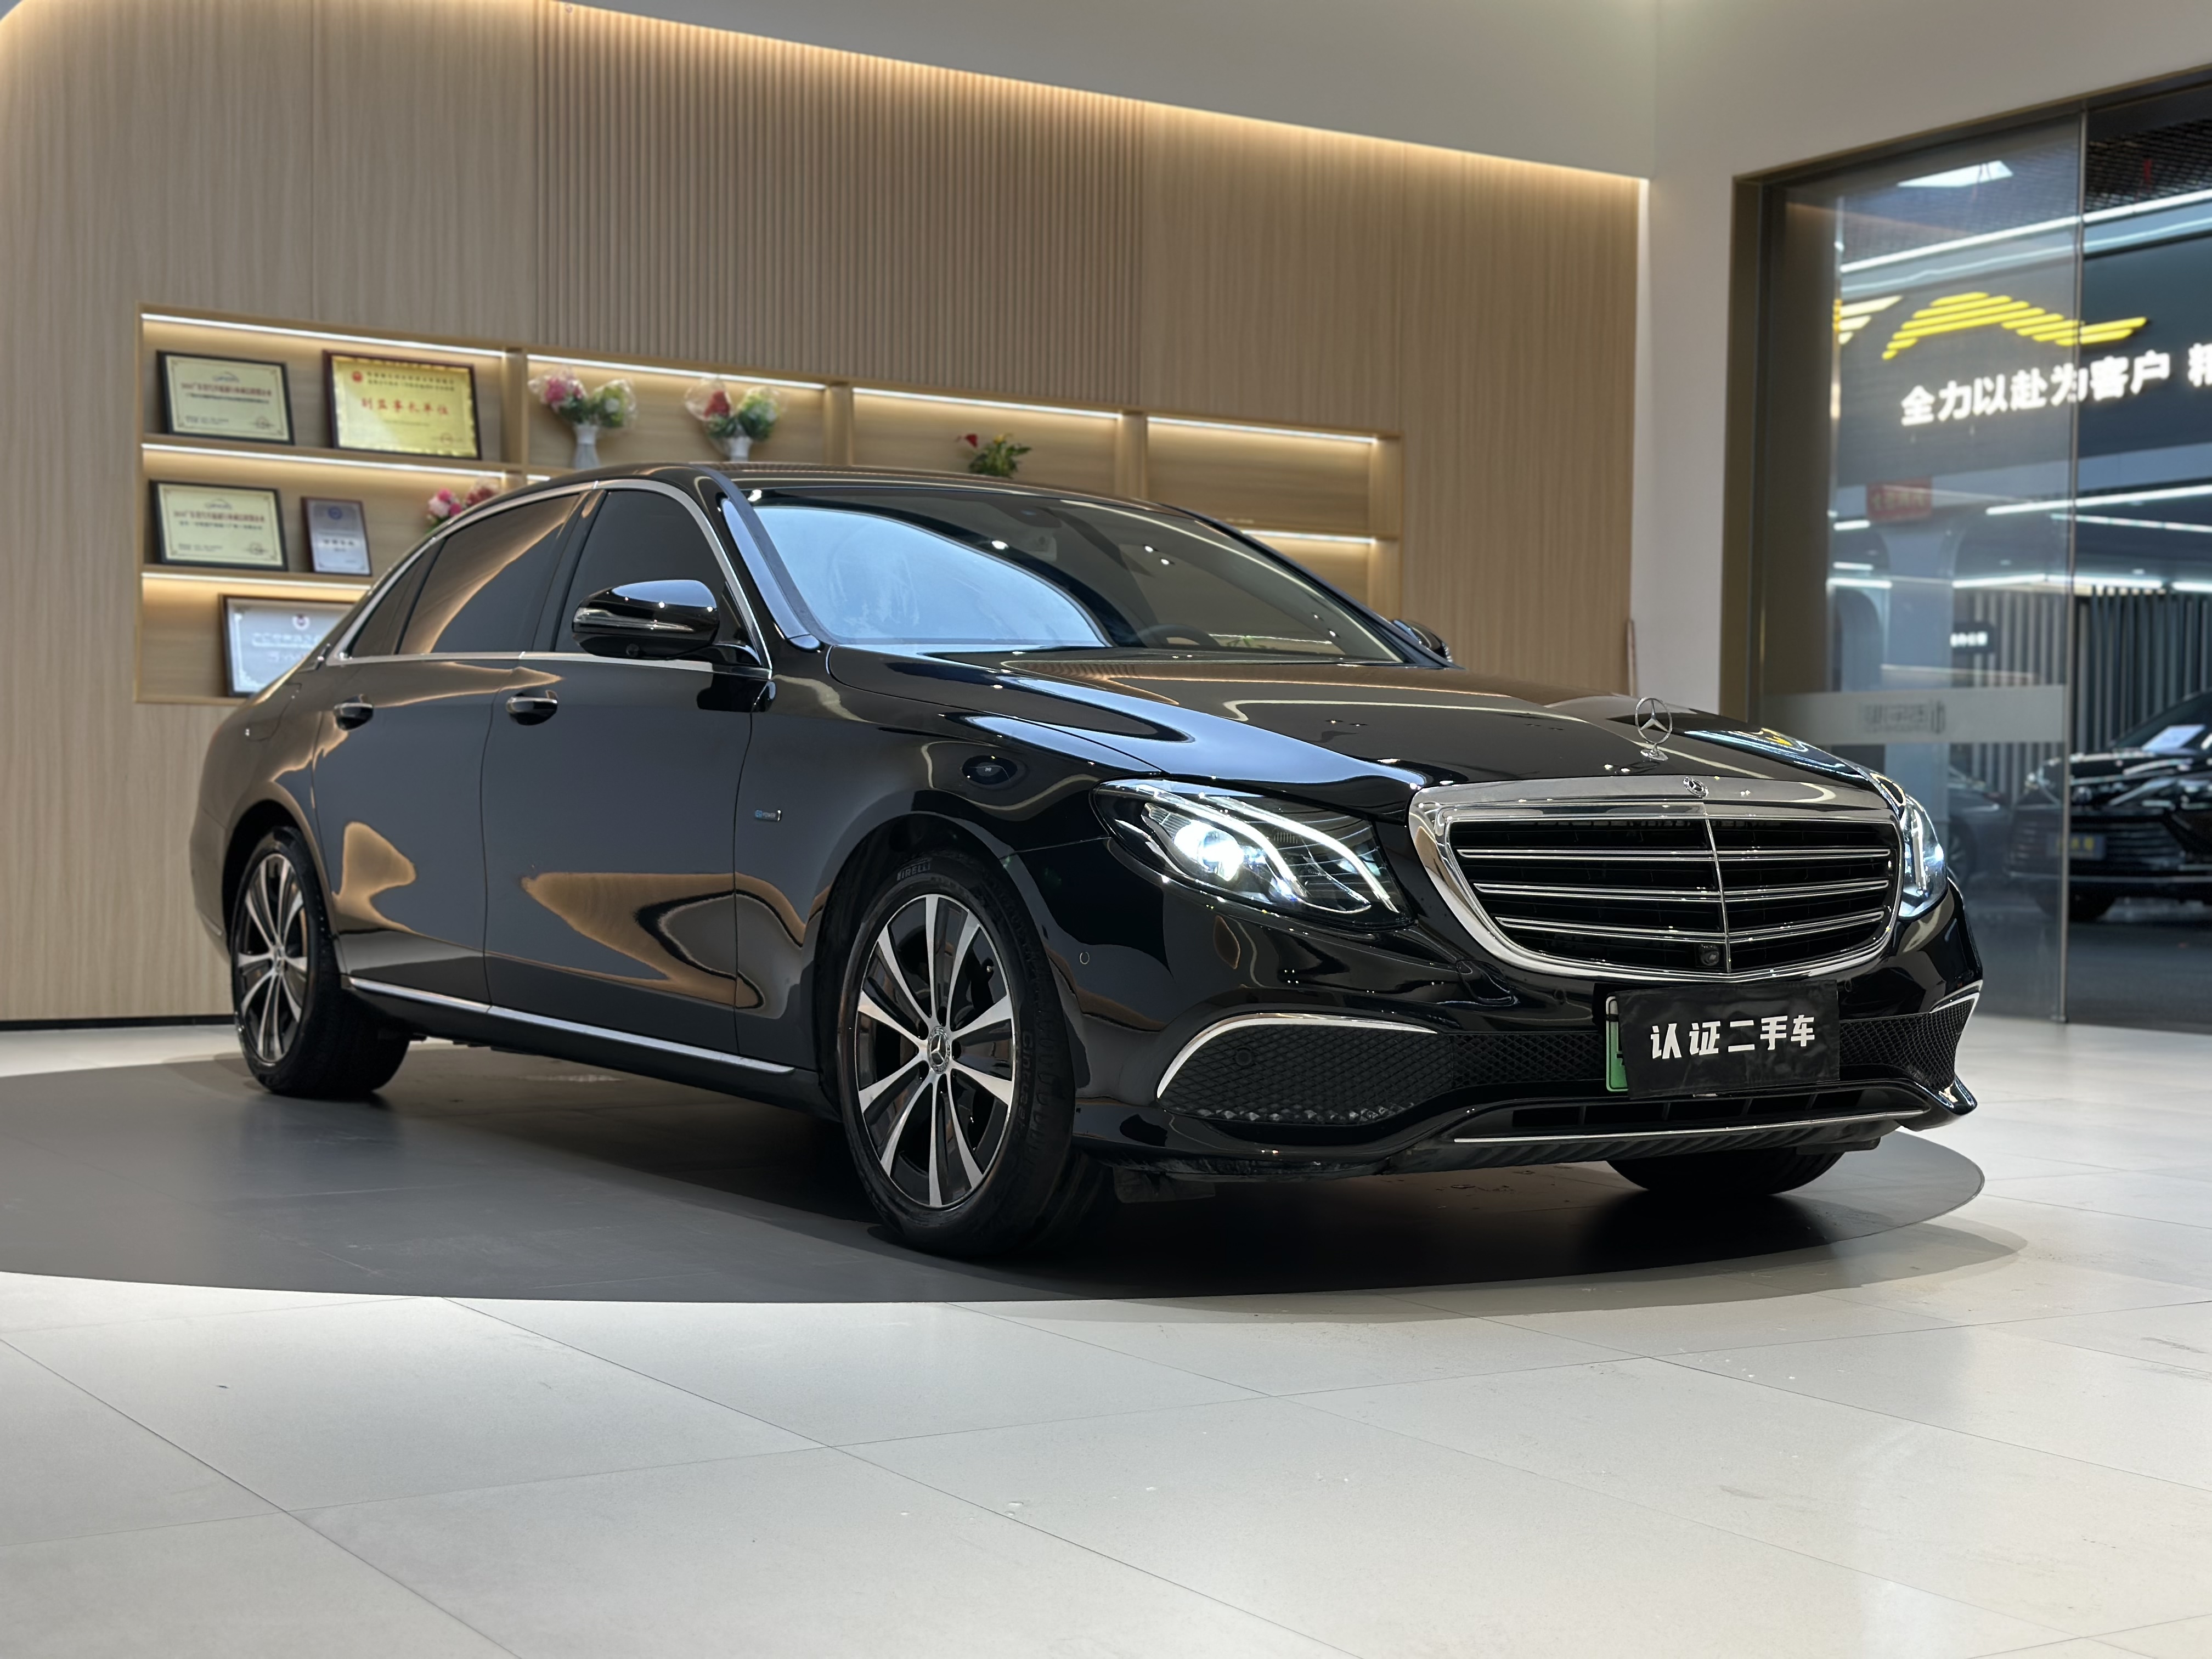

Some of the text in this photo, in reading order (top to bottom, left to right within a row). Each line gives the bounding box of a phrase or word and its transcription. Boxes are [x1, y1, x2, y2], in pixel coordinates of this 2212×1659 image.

[1901, 350, 2170, 426] 全力以赴为客户
[896, 859, 931, 881] PIRELLI
[1651, 1015, 1815, 1059] 认证二手车
